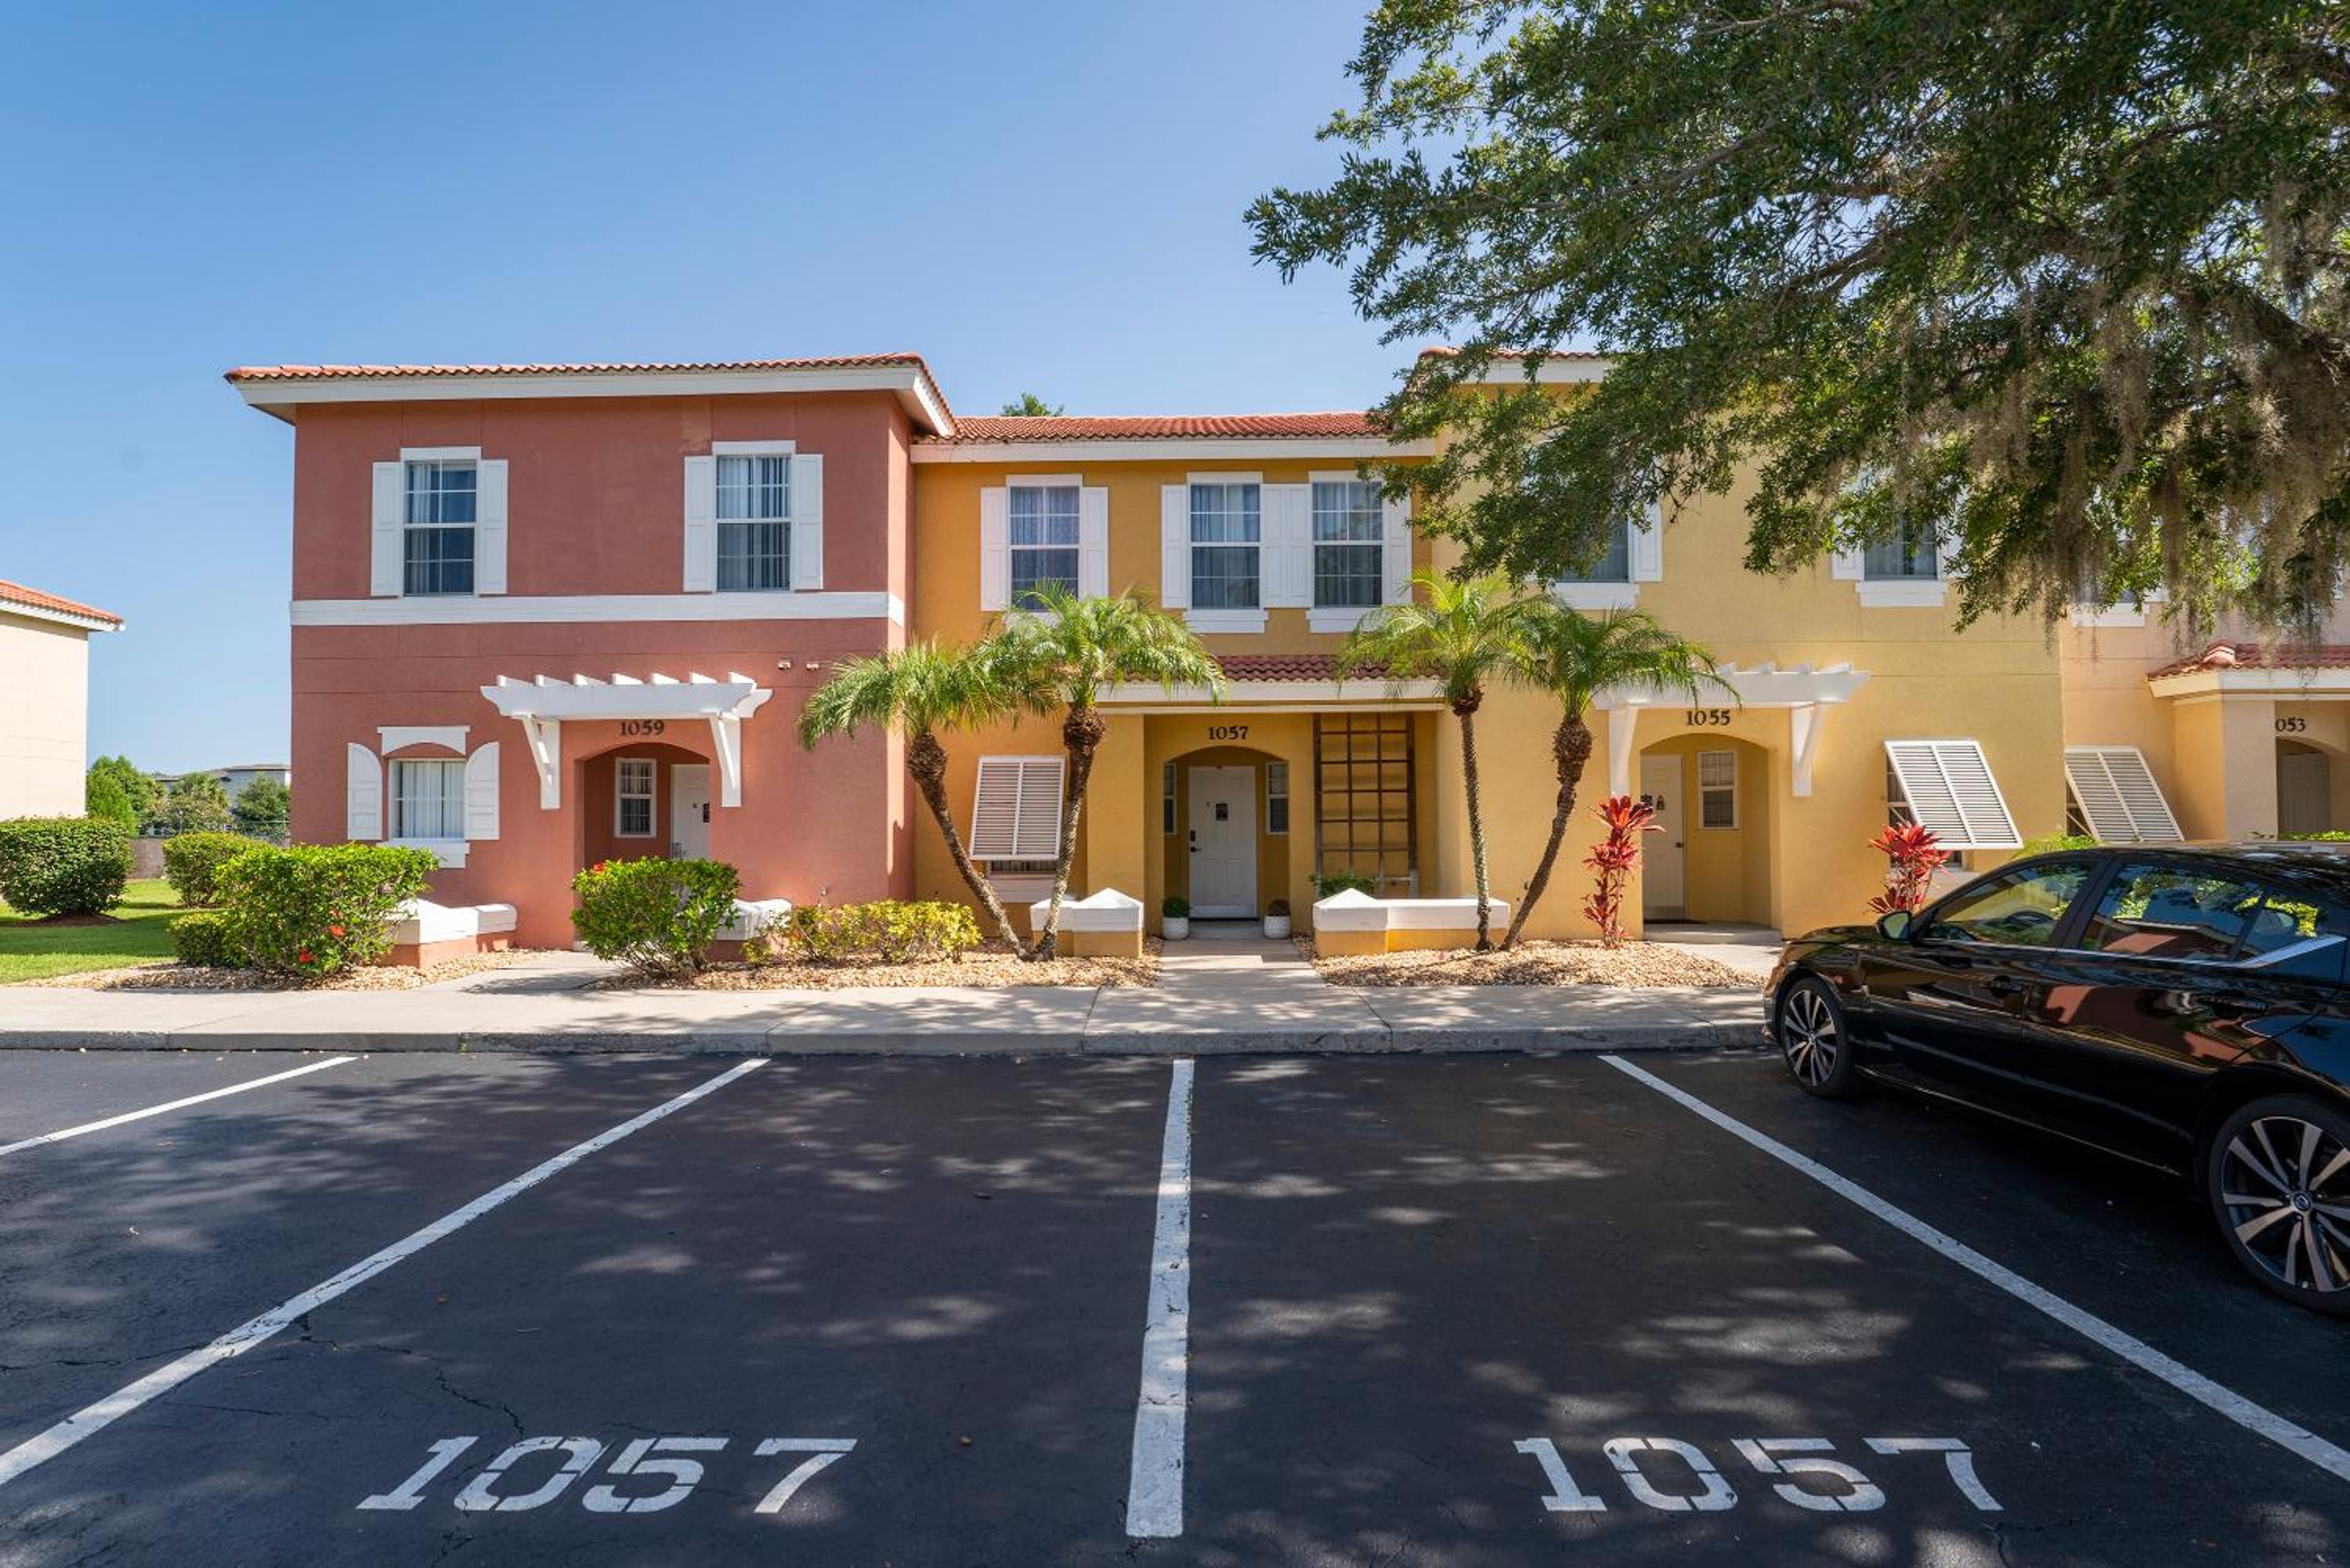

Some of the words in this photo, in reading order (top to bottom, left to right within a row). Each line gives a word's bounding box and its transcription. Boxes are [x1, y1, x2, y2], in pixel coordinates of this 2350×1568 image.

[1687, 709, 1730, 726] 1055
[2276, 717, 2306, 732] 053
[620, 719, 664, 736] 1059
[1208, 725, 1249, 740] 1057
[356, 1436, 859, 1514] 1057
[1513, 1436, 2003, 1512] 1057
